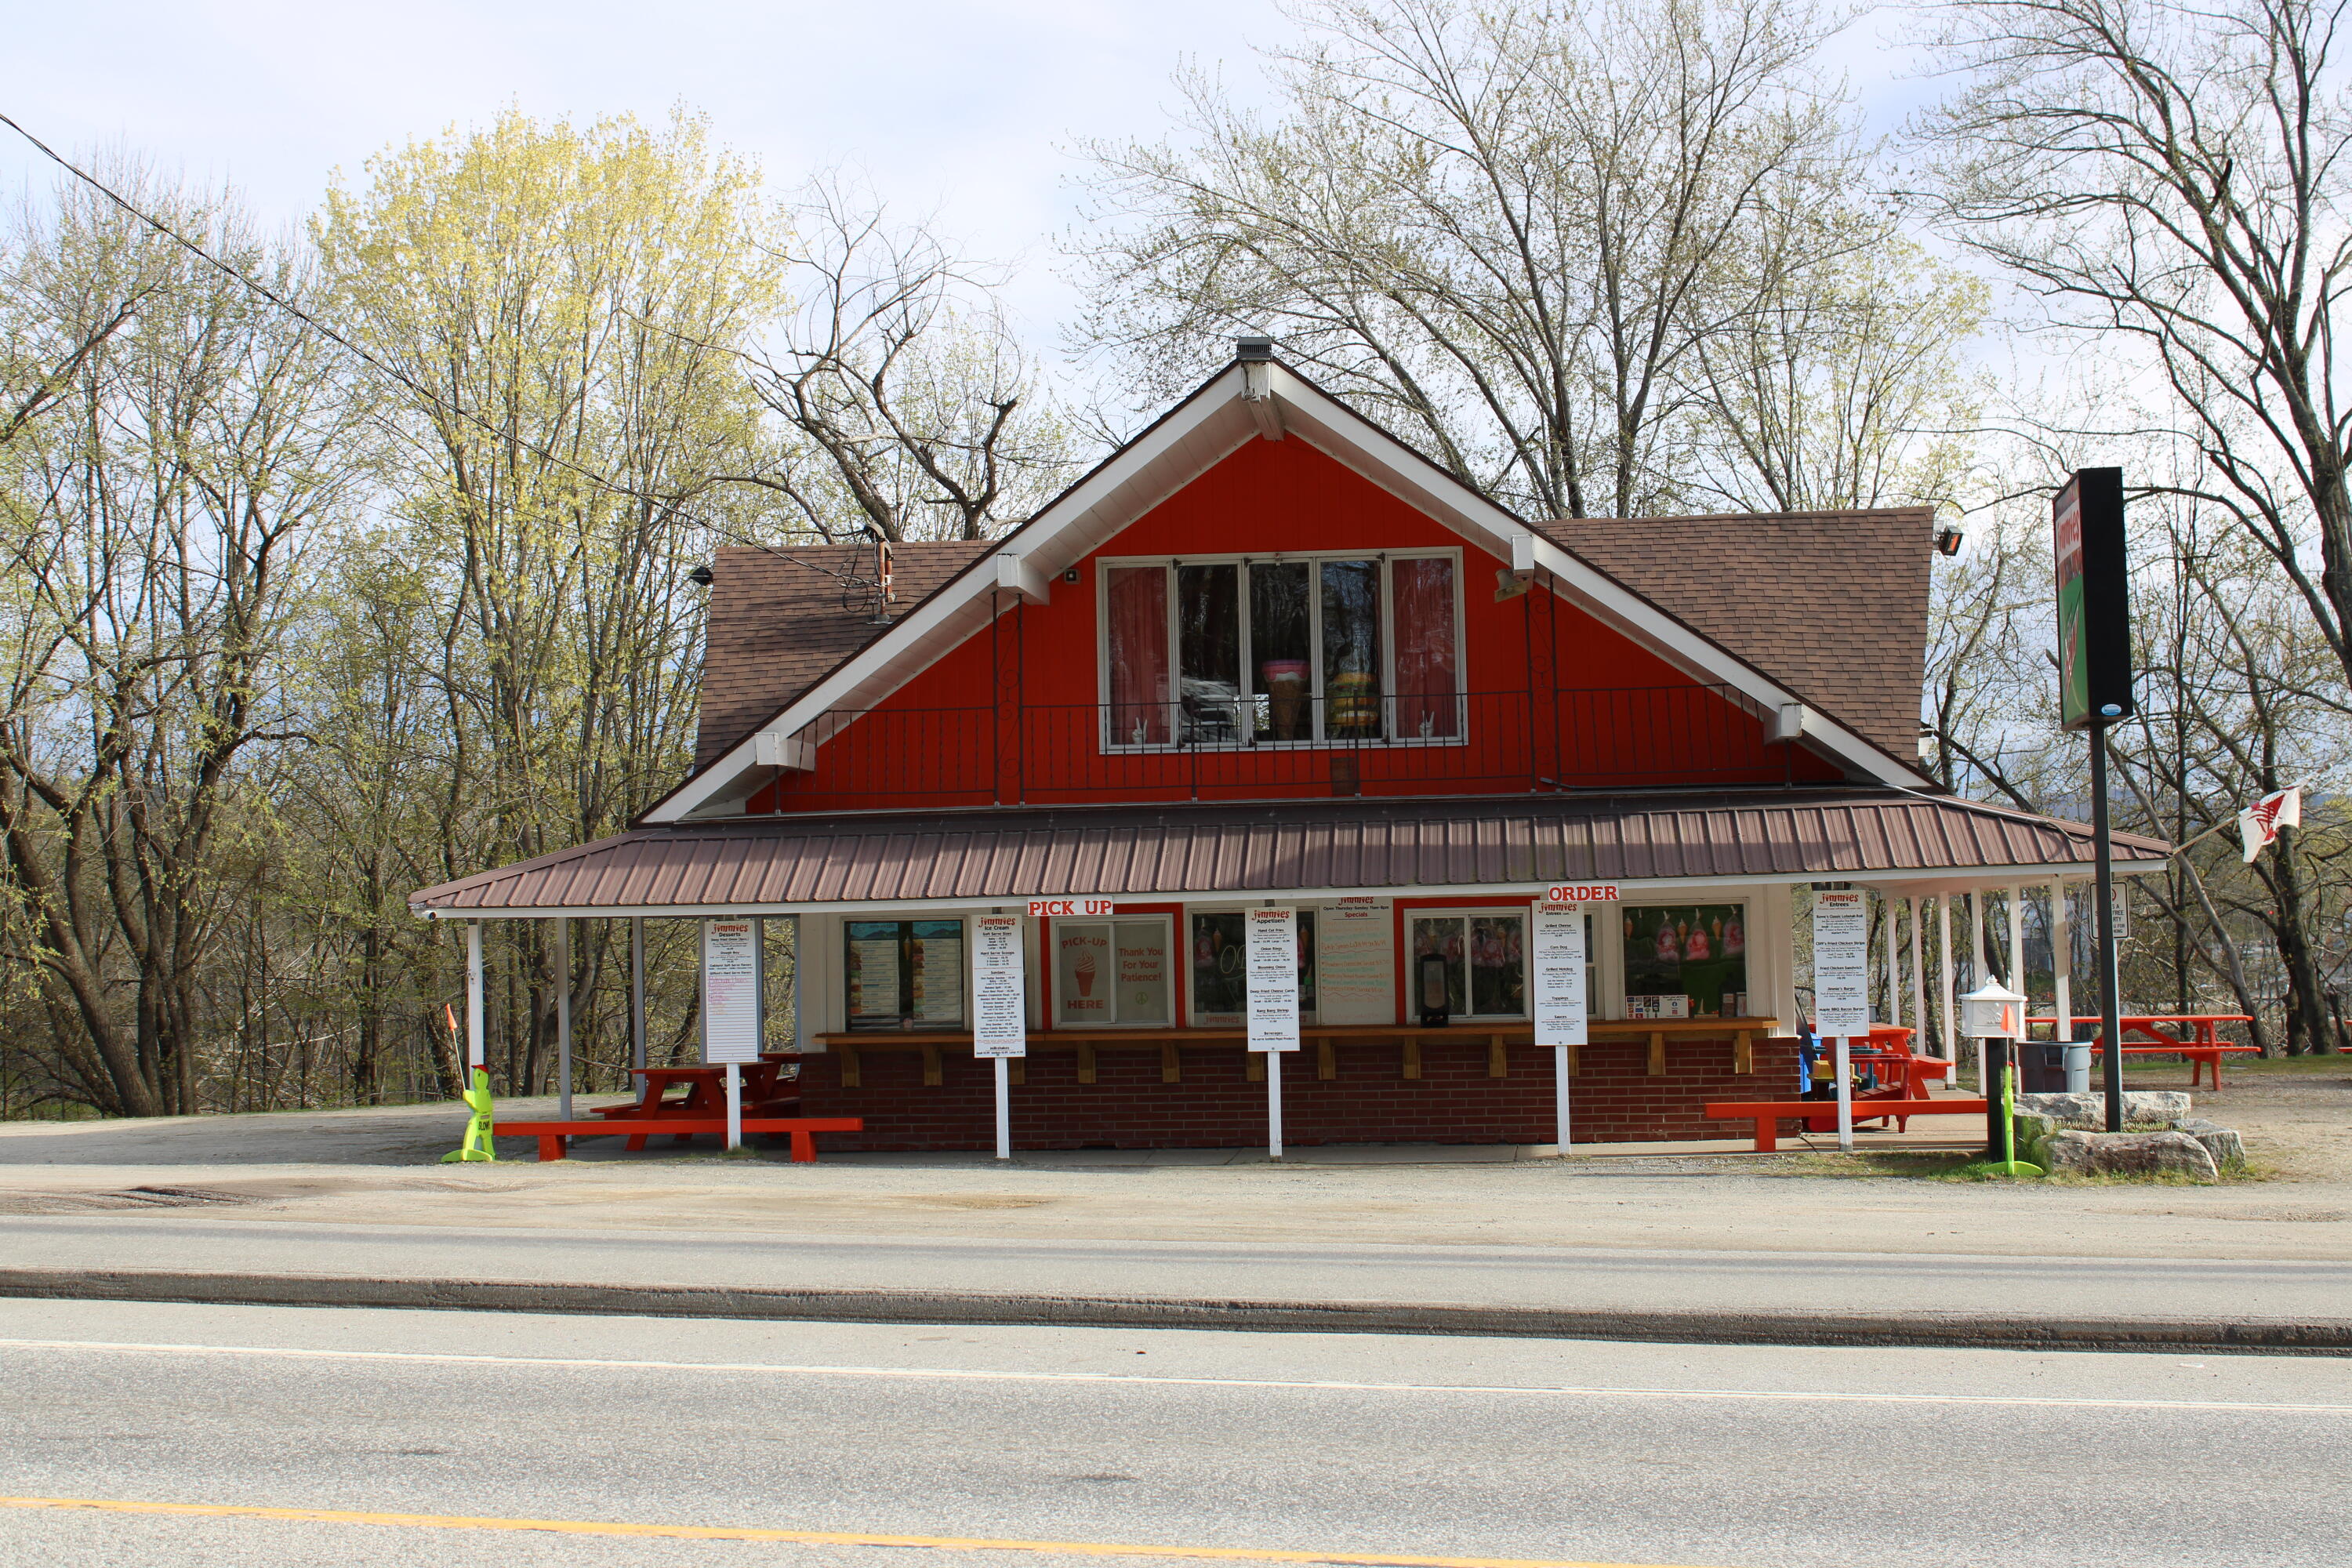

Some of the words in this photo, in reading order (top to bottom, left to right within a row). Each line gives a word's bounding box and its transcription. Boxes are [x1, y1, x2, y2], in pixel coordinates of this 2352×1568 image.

[1549, 886, 1618, 901] ORDER
[1820, 893, 1859, 904] jimmies
[1338, 897, 1374, 906] jimmies
[1029, 901, 1074, 916] PICK
[1085, 901, 1112, 915] UP
[1538, 902, 1577, 913] jimmies
[1251, 909, 1290, 920] jimmies
[978, 916, 1016, 927] jimmies
[711, 924, 749, 935] jimmies
[1062, 936, 1108, 949] PICK-UP
[1119, 948, 1144, 956] Thank
[1147, 947, 1163, 956] You
[1123, 960, 1136, 969] For
[1139, 960, 1158, 968] Your
[1121, 973, 1162, 982] Patience!
[1067, 1000, 1104, 1009] HERE
